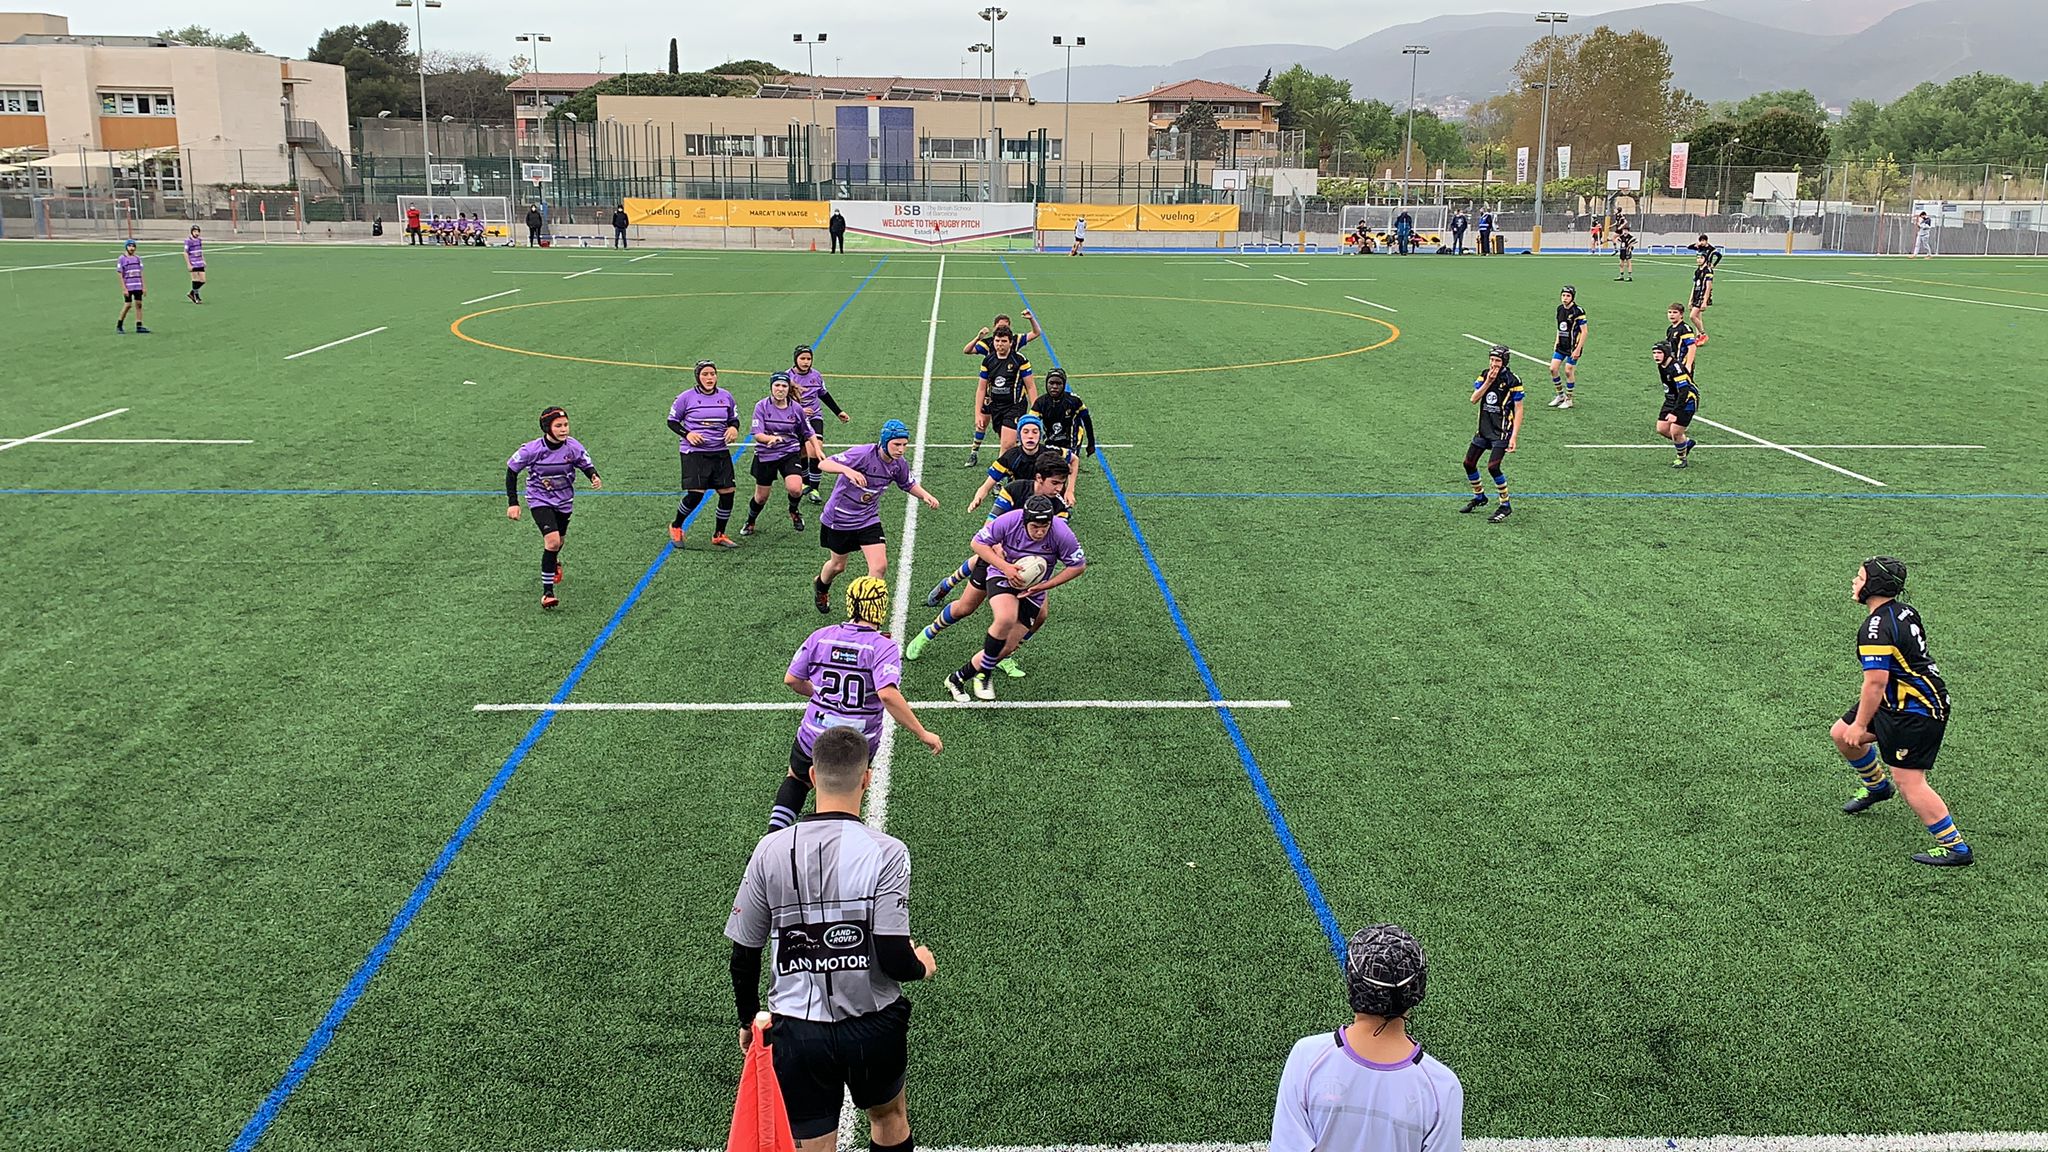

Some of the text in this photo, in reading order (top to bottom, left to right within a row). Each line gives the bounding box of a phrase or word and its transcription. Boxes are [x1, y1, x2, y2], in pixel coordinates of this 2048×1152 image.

[645, 206, 680, 218] vueling
[895, 205, 921, 216] BSB
[1160, 211, 1195, 223] vueling
[882, 219, 914, 228] WELCOME
[915, 219, 924, 228] TO
[938, 219, 960, 229] RUGBY
[961, 220, 980, 229] PITCH
[819, 669, 866, 709] 20
